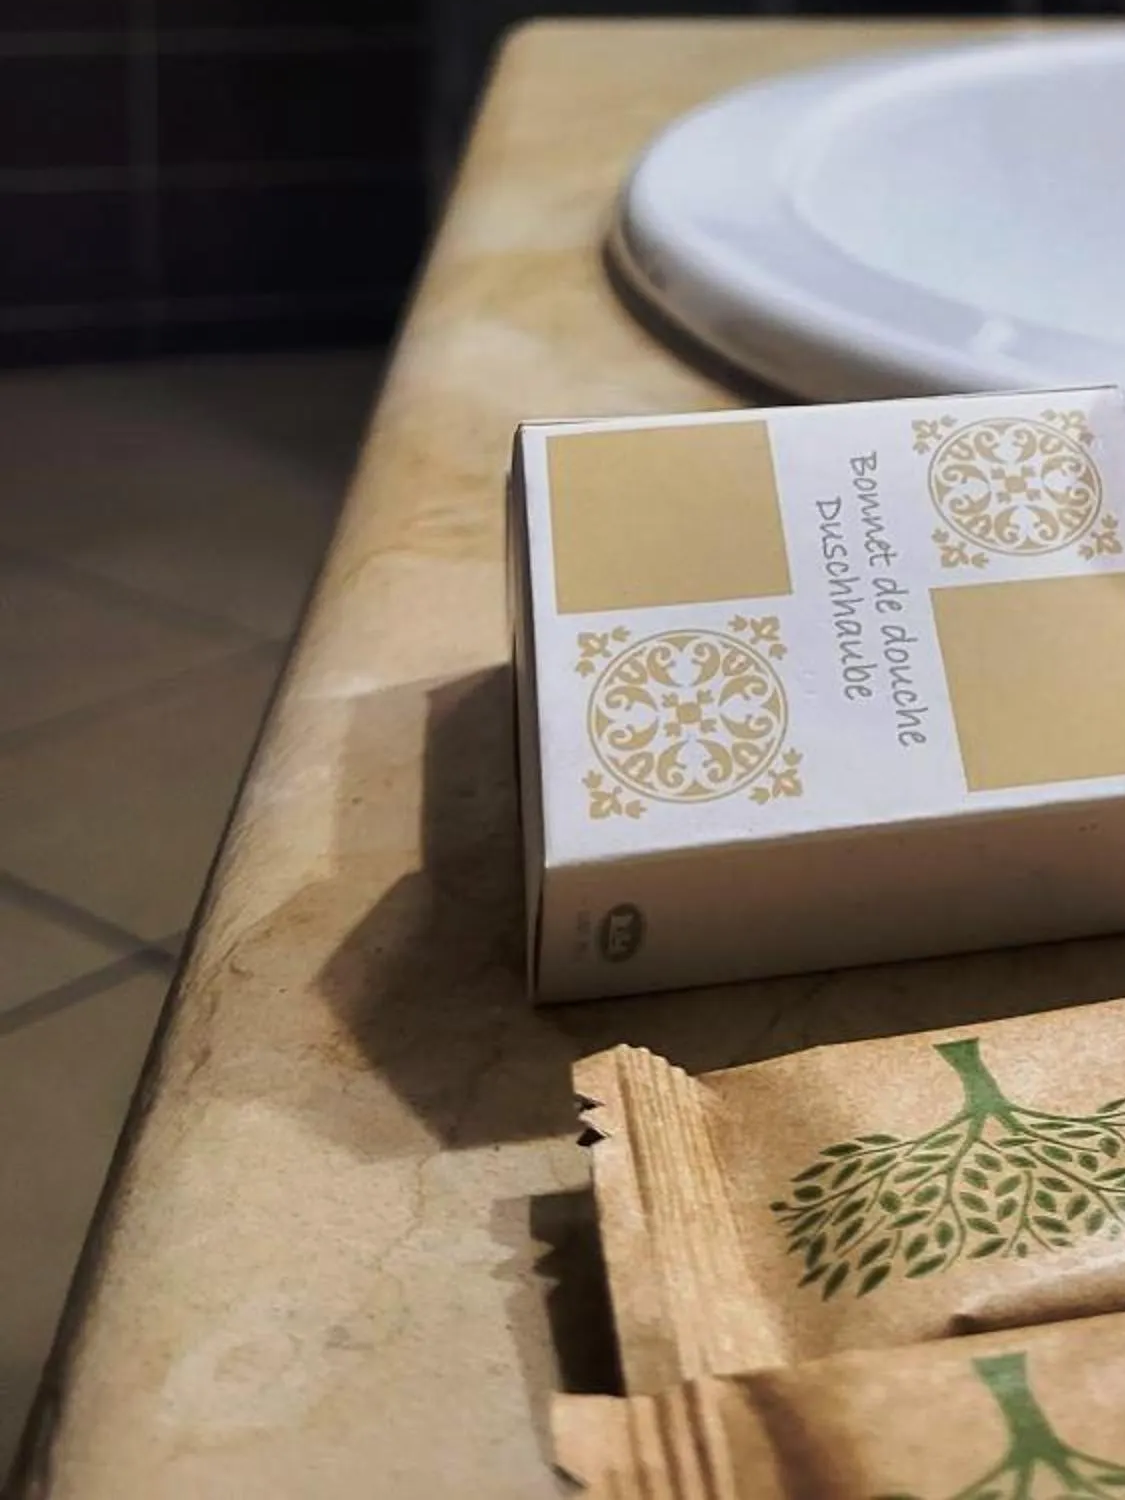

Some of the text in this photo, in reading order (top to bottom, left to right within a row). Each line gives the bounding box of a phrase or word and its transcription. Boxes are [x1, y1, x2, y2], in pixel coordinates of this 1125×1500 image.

[815, 496, 879, 701] Duschhaube
[850, 450, 930, 747] Bonnet de douche
